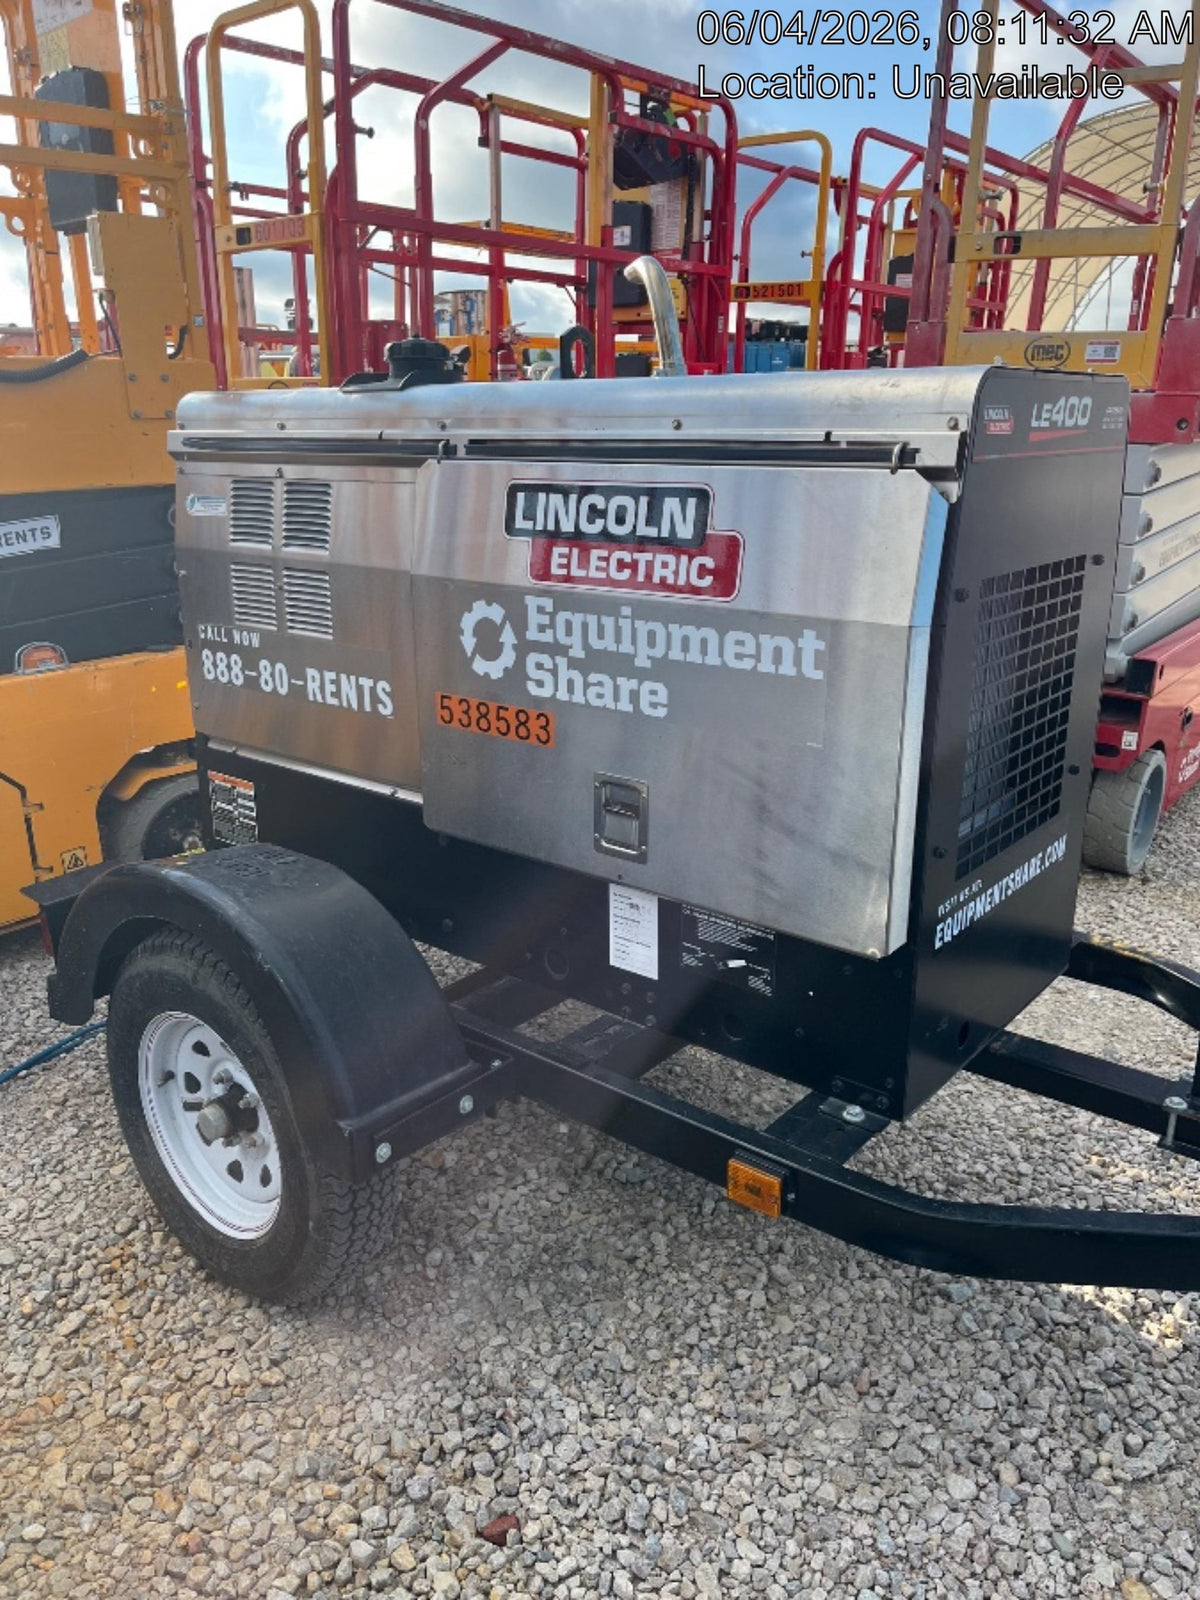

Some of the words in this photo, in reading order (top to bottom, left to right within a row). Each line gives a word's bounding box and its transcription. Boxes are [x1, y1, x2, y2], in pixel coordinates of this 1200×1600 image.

[753, 283, 802, 298] 521501
[1031, 396, 1092, 428] LE400
[0, 525, 53, 548] ENTS
[514, 491, 698, 540] LINCOLN
[551, 546, 716, 588] ELECTRIC
[199, 624, 229, 644] CALL
[232, 628, 261, 649] NOW
[523, 595, 826, 680] Equipment
[201, 648, 395, 717] 888-80-RENTS
[525, 651, 669, 719] Share
[439, 694, 552, 746] 538583
[934, 832, 1067, 951] EQUIPMENTSHARE.COM
